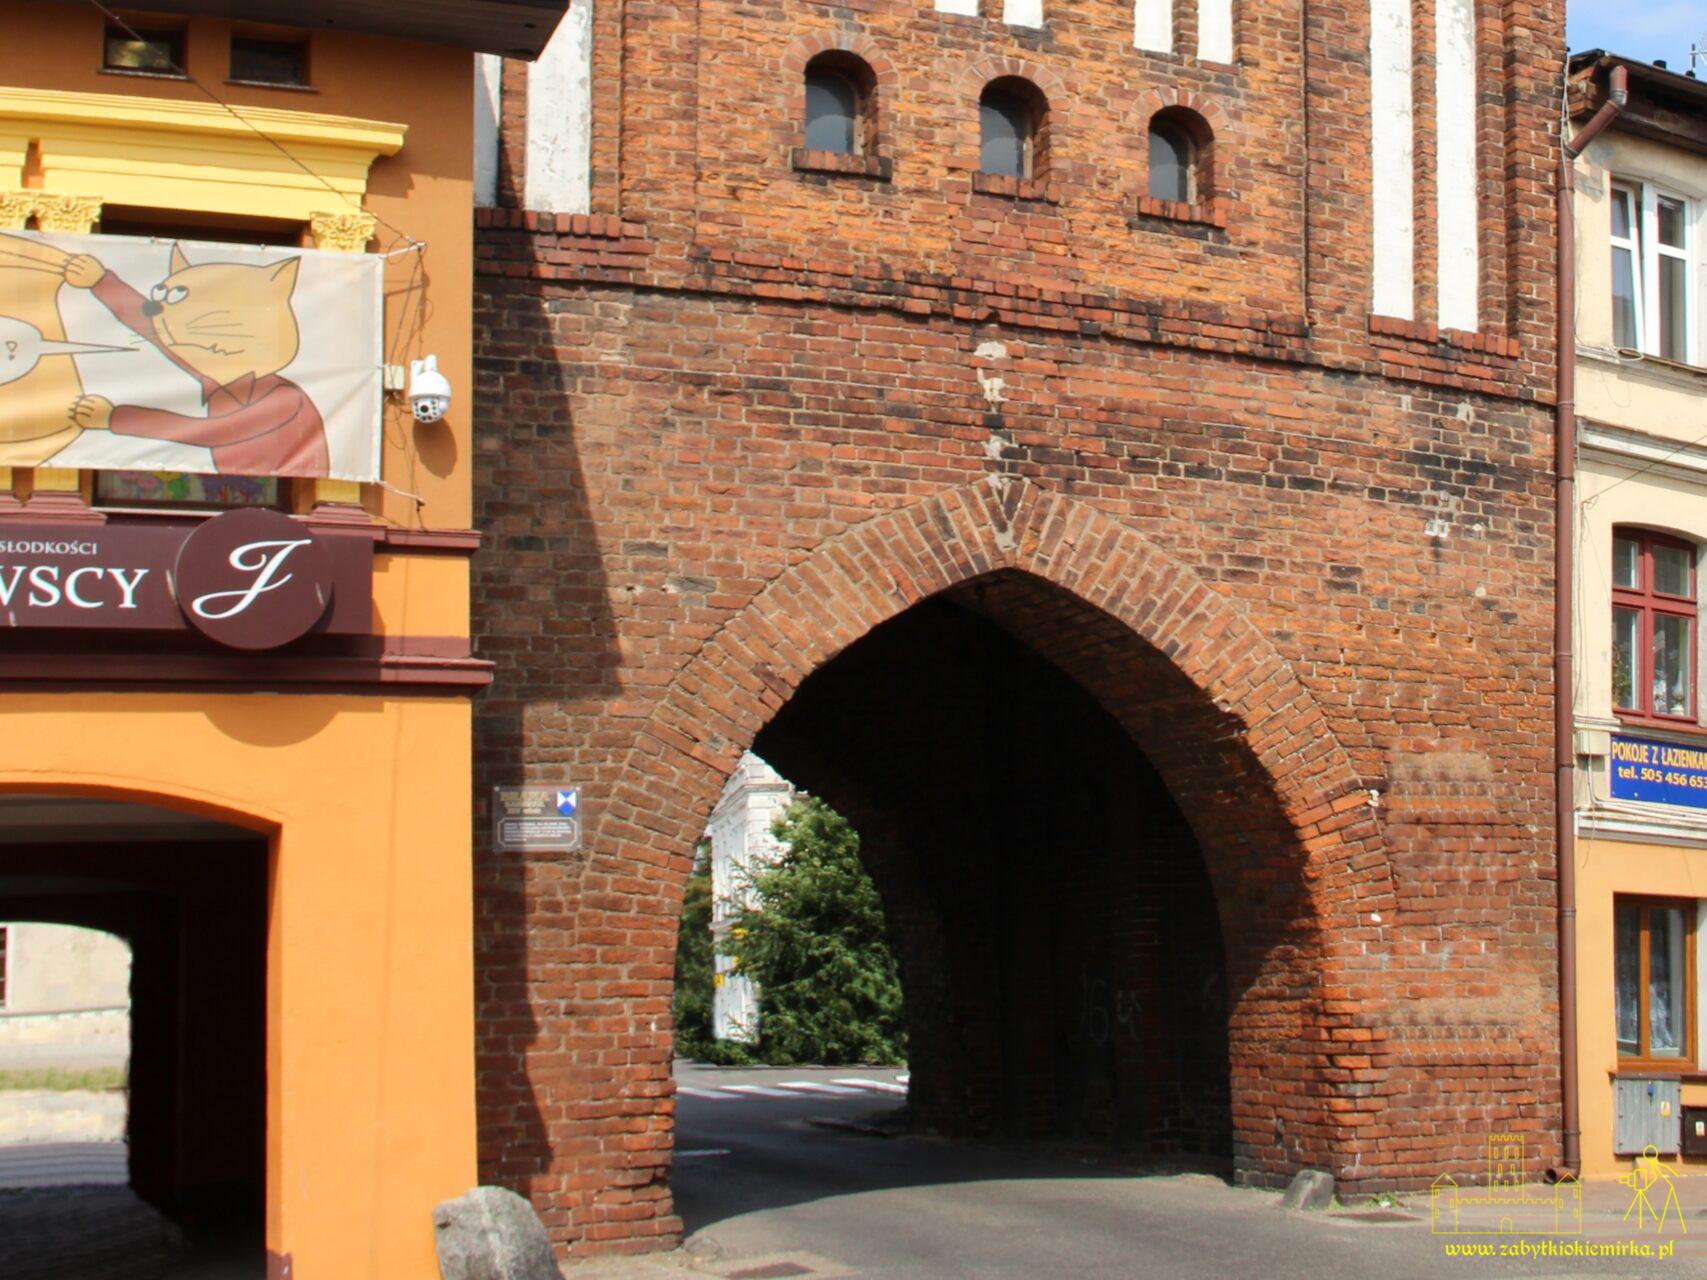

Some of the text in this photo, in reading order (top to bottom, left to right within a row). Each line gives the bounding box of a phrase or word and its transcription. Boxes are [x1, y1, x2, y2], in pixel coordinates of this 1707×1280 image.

[1612, 741, 1649, 764] POKOJE
[1651, 746, 1659, 765] Z
[1618, 765, 1638, 779] tel.
[1640, 767, 1662, 783] 505
[1665, 772, 1687, 786] 456
